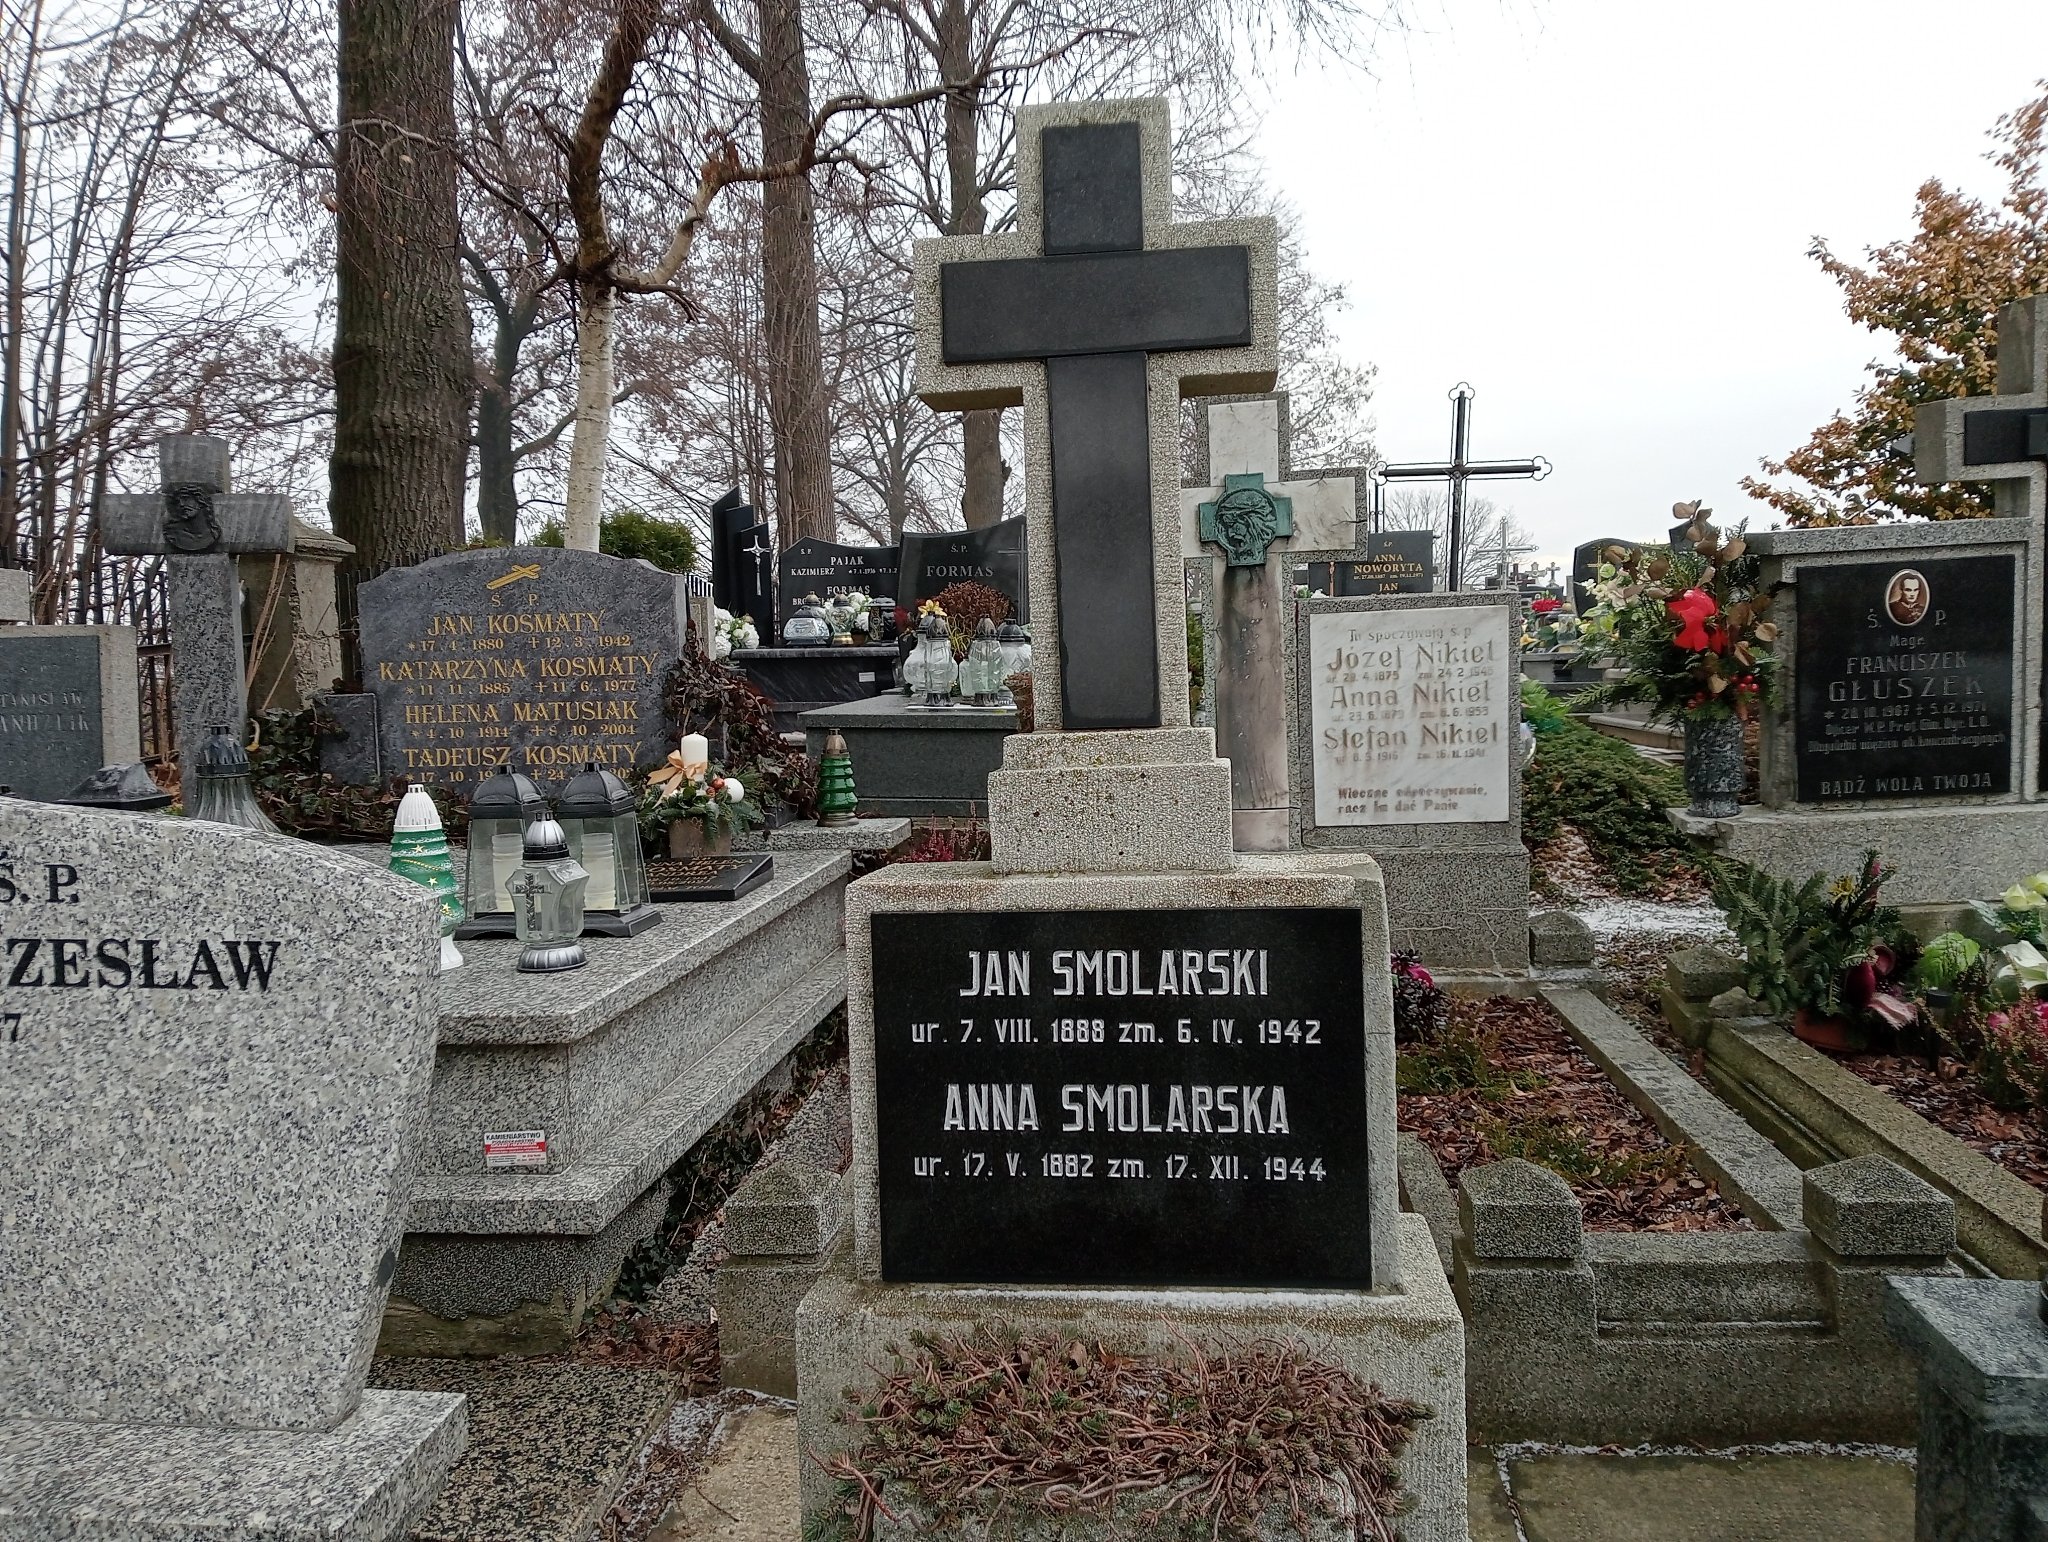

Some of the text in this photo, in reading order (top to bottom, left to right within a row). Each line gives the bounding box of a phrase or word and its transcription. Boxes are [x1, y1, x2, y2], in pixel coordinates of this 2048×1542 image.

[1354, 563, 1423, 574] NOWORYTA
[1373, 554, 1404, 563] ANNA
[791, 568, 835, 576] KAZIMIERZ
[926, 565, 994, 577] FORMAS
[826, 585, 871, 595] FORMAS
[1379, 583, 1399, 591] JAN
[427, 609, 606, 636] JAN KOSMATY
[472, 637, 504, 650] 1880
[598, 634, 632, 647] 1942
[1348, 628, 1361, 642] Tu
[1368, 624, 1443, 643] spoczywają
[1416, 639, 1494, 671] Nikiel
[1846, 652, 1968, 675] FRANCISZEK
[380, 652, 660, 680] KATARZYNA KOSMATY
[479, 682, 511, 694] 1885
[604, 679, 637, 692] 1977
[1330, 680, 1490, 709] Anna Nikiel
[1828, 675, 1985, 702] GŁUSZEK
[405, 700, 639, 724] HELENA MATUSIAK
[478, 726, 510, 738] 1914
[600, 723, 637, 735] 2004
[1324, 722, 1498, 750] Stefan Nikiel
[402, 741, 642, 768] TADEUSZ KOSMATY
[1875, 777, 1924, 792] WOLA
[1933, 772, 1993, 790] TWOJA
[1338, 788, 1388, 799] Wieczne
[1337, 804, 1367, 814] racz
[1395, 799, 1417, 812] dać
[44, 863, 79, 904] P.
[959, 949, 1269, 997] JAN SMOLARSKI
[911, 1018, 1322, 1045] ur. 7. VIII. 1888 zm. 6. IV. 1942
[943, 1083, 1290, 1134] ANNA SMOLARSKA
[486, 1132, 541, 1140] KAMIENIARSTWO
[914, 1152, 1327, 1181] ur. 17. V. 1882 zm. 17. XII. 1944
